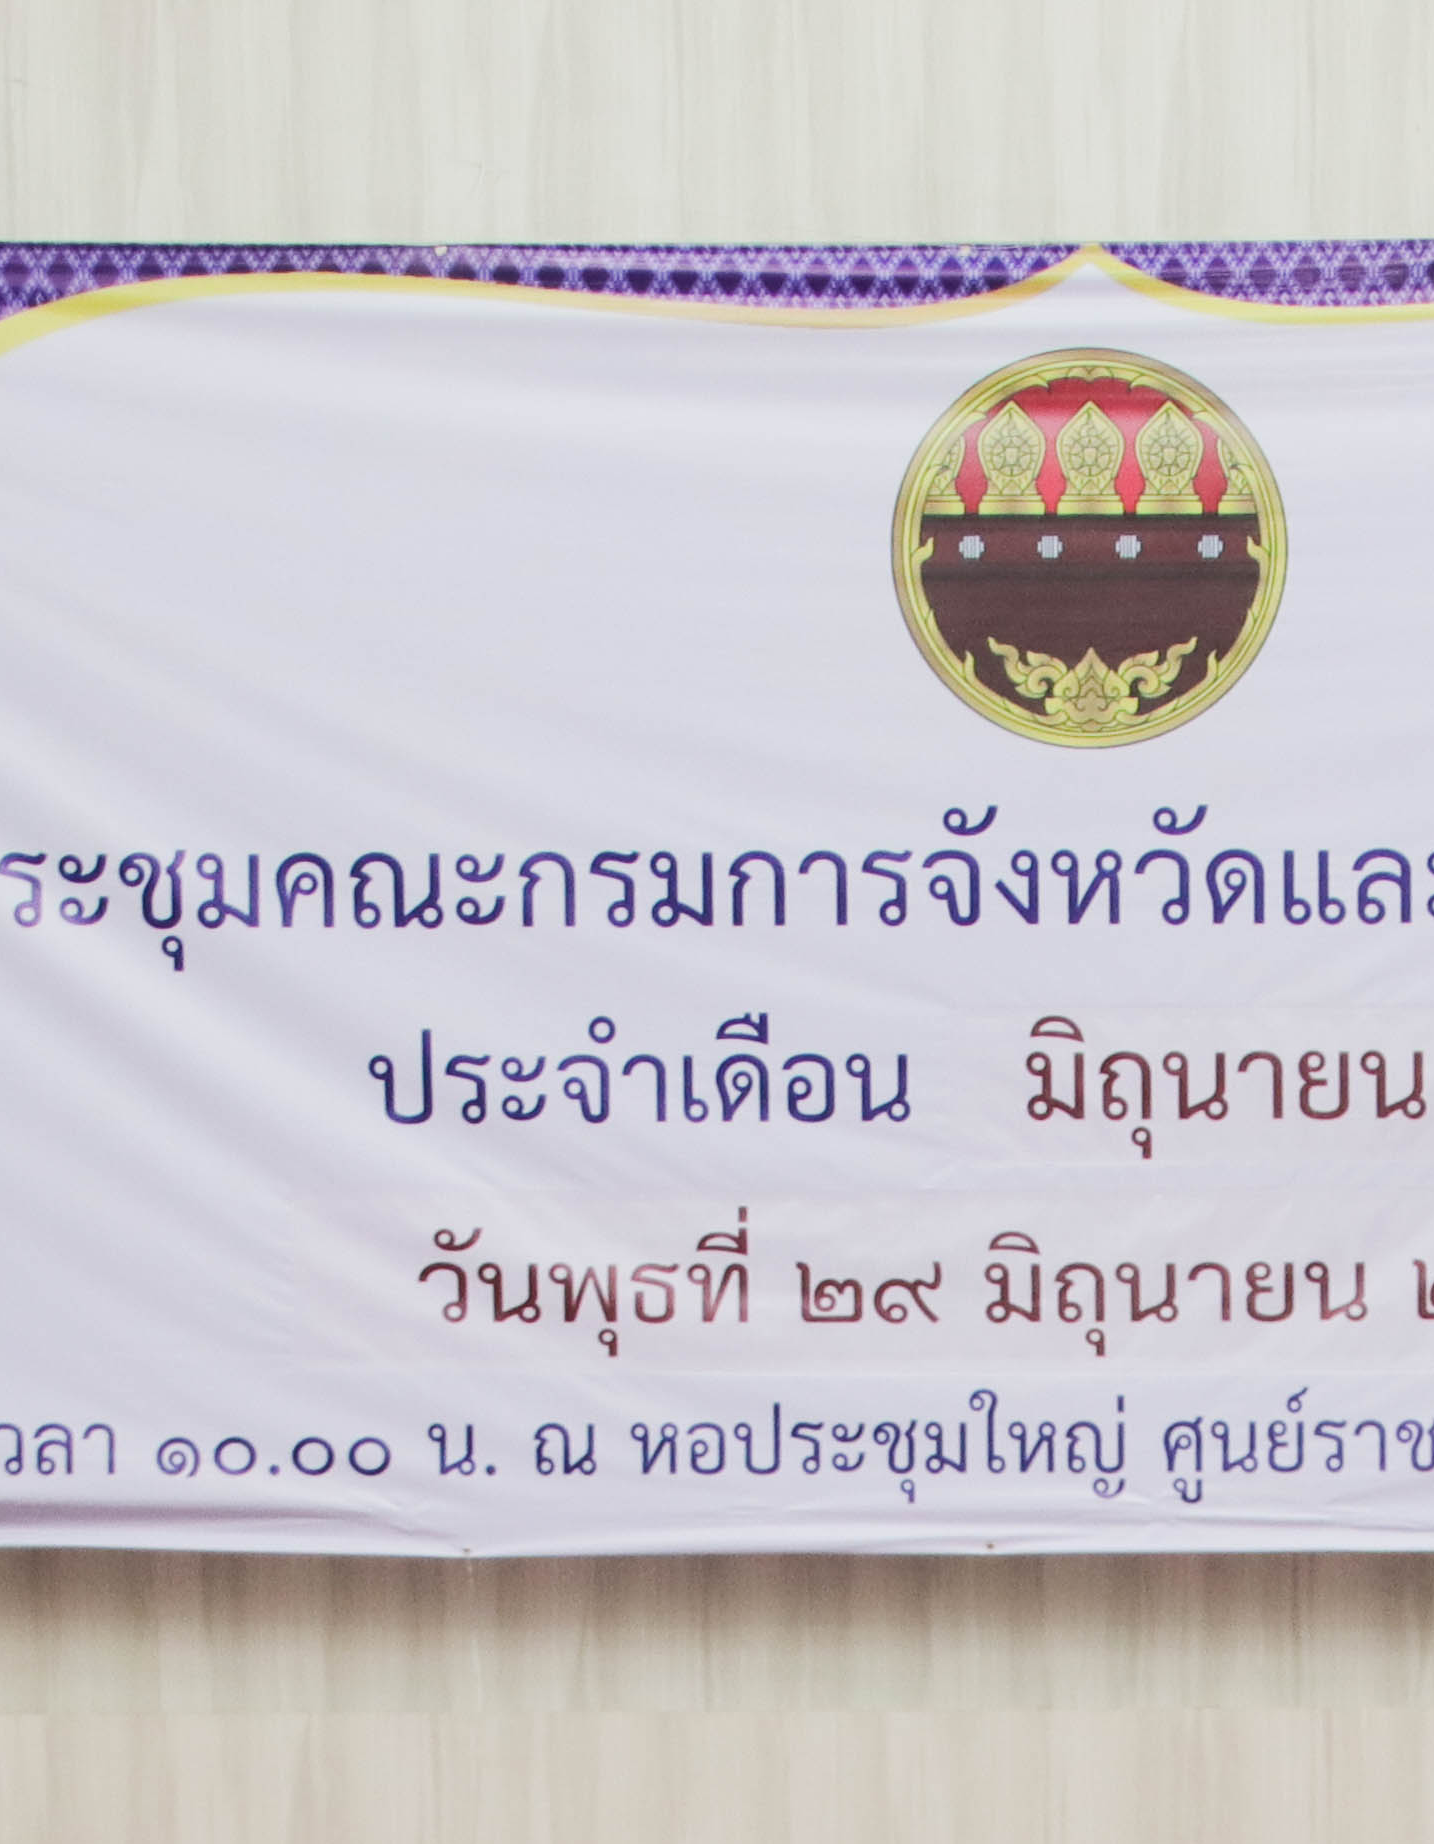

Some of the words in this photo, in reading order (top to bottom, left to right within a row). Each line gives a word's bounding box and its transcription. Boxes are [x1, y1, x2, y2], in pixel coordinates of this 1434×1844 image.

[368, 1012, 911, 1125] ประจำเดือน
[1026, 1015, 1427, 1159] มิถุนายน
[419, 1206, 749, 1357] วันพุธที่
[796, 1261, 943, 1324] ๒๙
[985, 1231, 1368, 1357] มิถุนายน
[156, 1436, 392, 1477] ๑๐.๐๐
[427, 1423, 497, 1477] น.
[533, 1422, 597, 1477] ณ
[630, 1389, 1126, 1505] หอประชุมใหญ่
